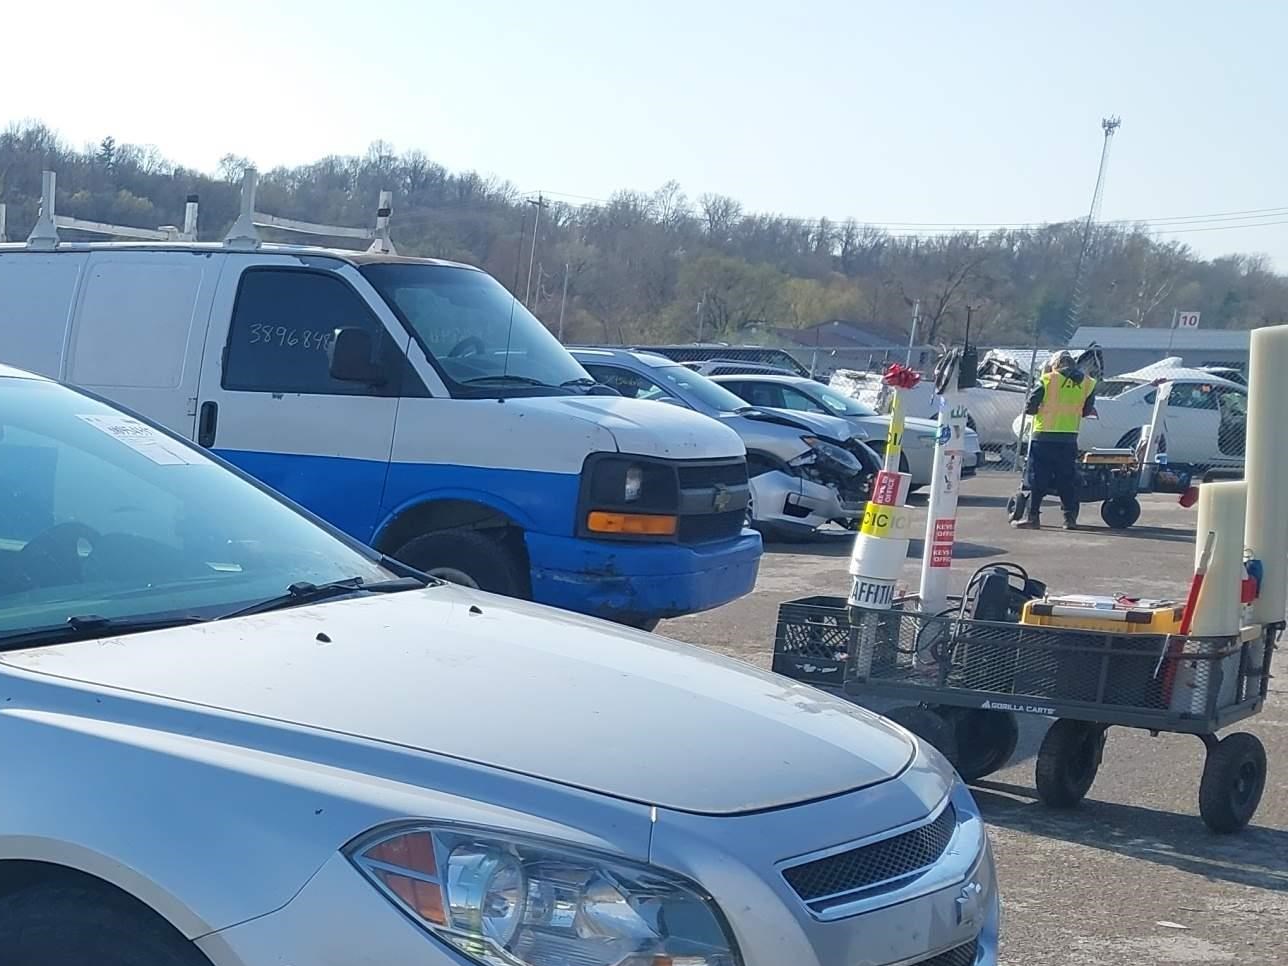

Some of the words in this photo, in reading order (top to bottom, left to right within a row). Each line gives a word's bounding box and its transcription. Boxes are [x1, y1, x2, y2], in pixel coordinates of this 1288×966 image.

[1182, 315, 1198, 326] 10
[992, 702, 1024, 711] GORILLA
[1026, 706, 1056, 714] CARTS
